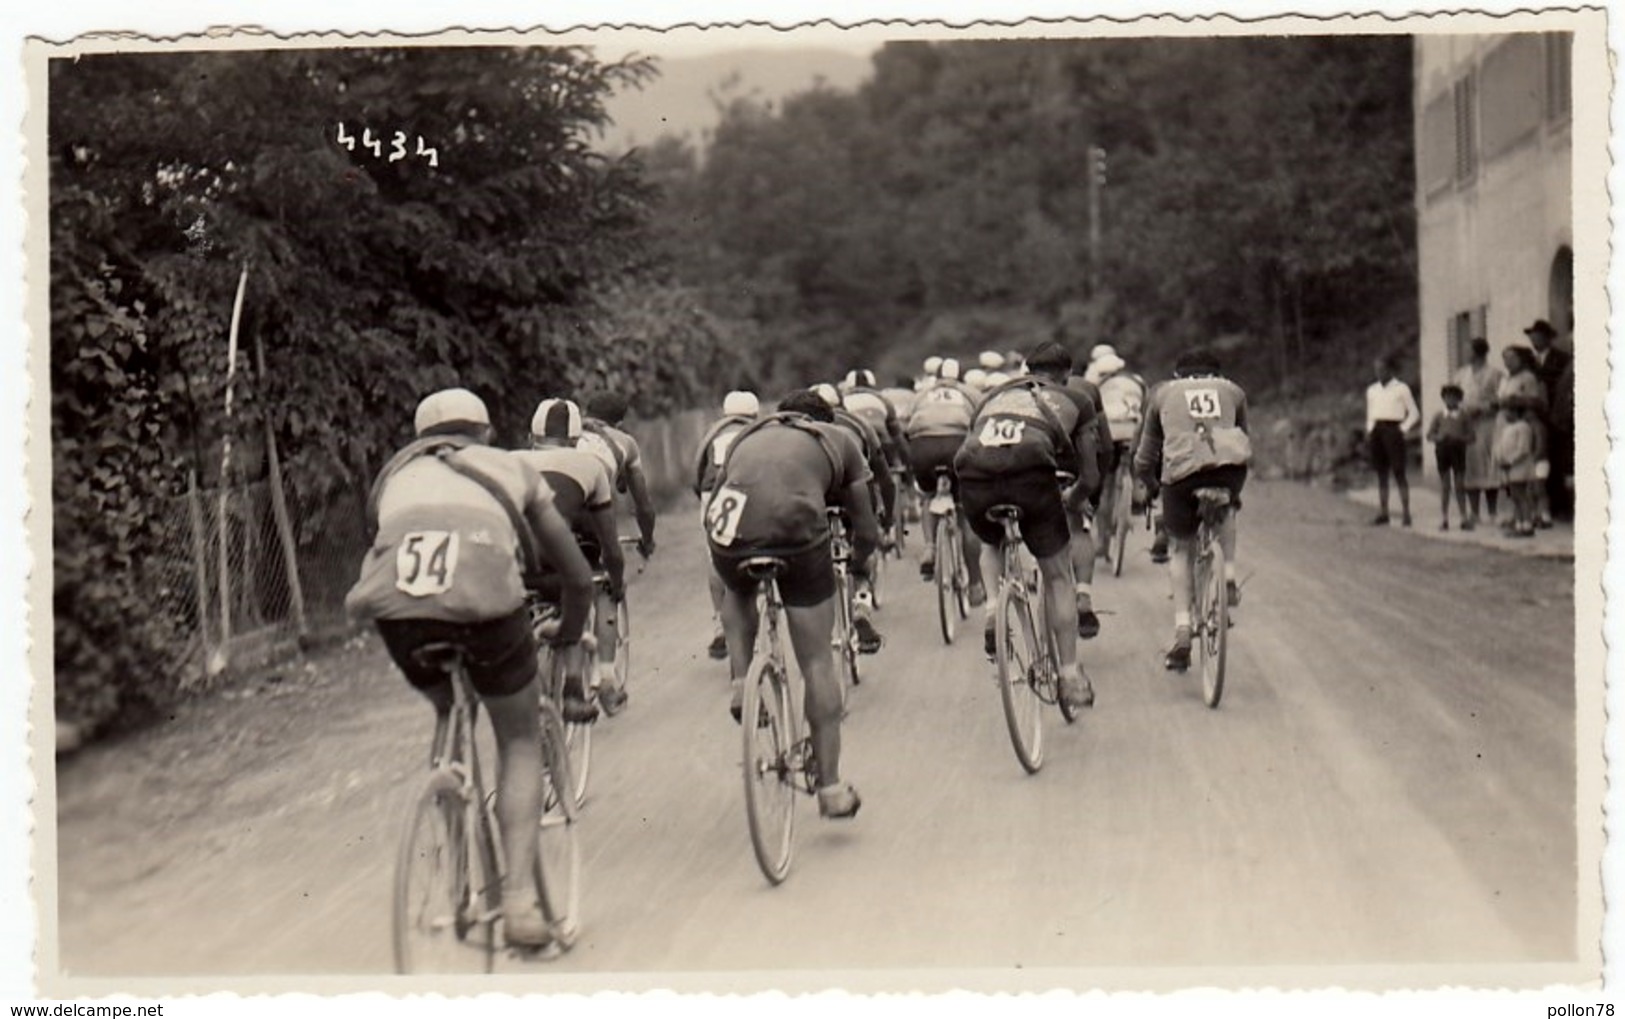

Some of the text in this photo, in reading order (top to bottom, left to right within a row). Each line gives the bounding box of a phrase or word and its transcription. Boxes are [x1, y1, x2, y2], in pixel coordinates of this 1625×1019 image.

[338, 121, 438, 167] 4434
[1190, 393, 1215, 415] 45
[405, 534, 450, 586] 54
